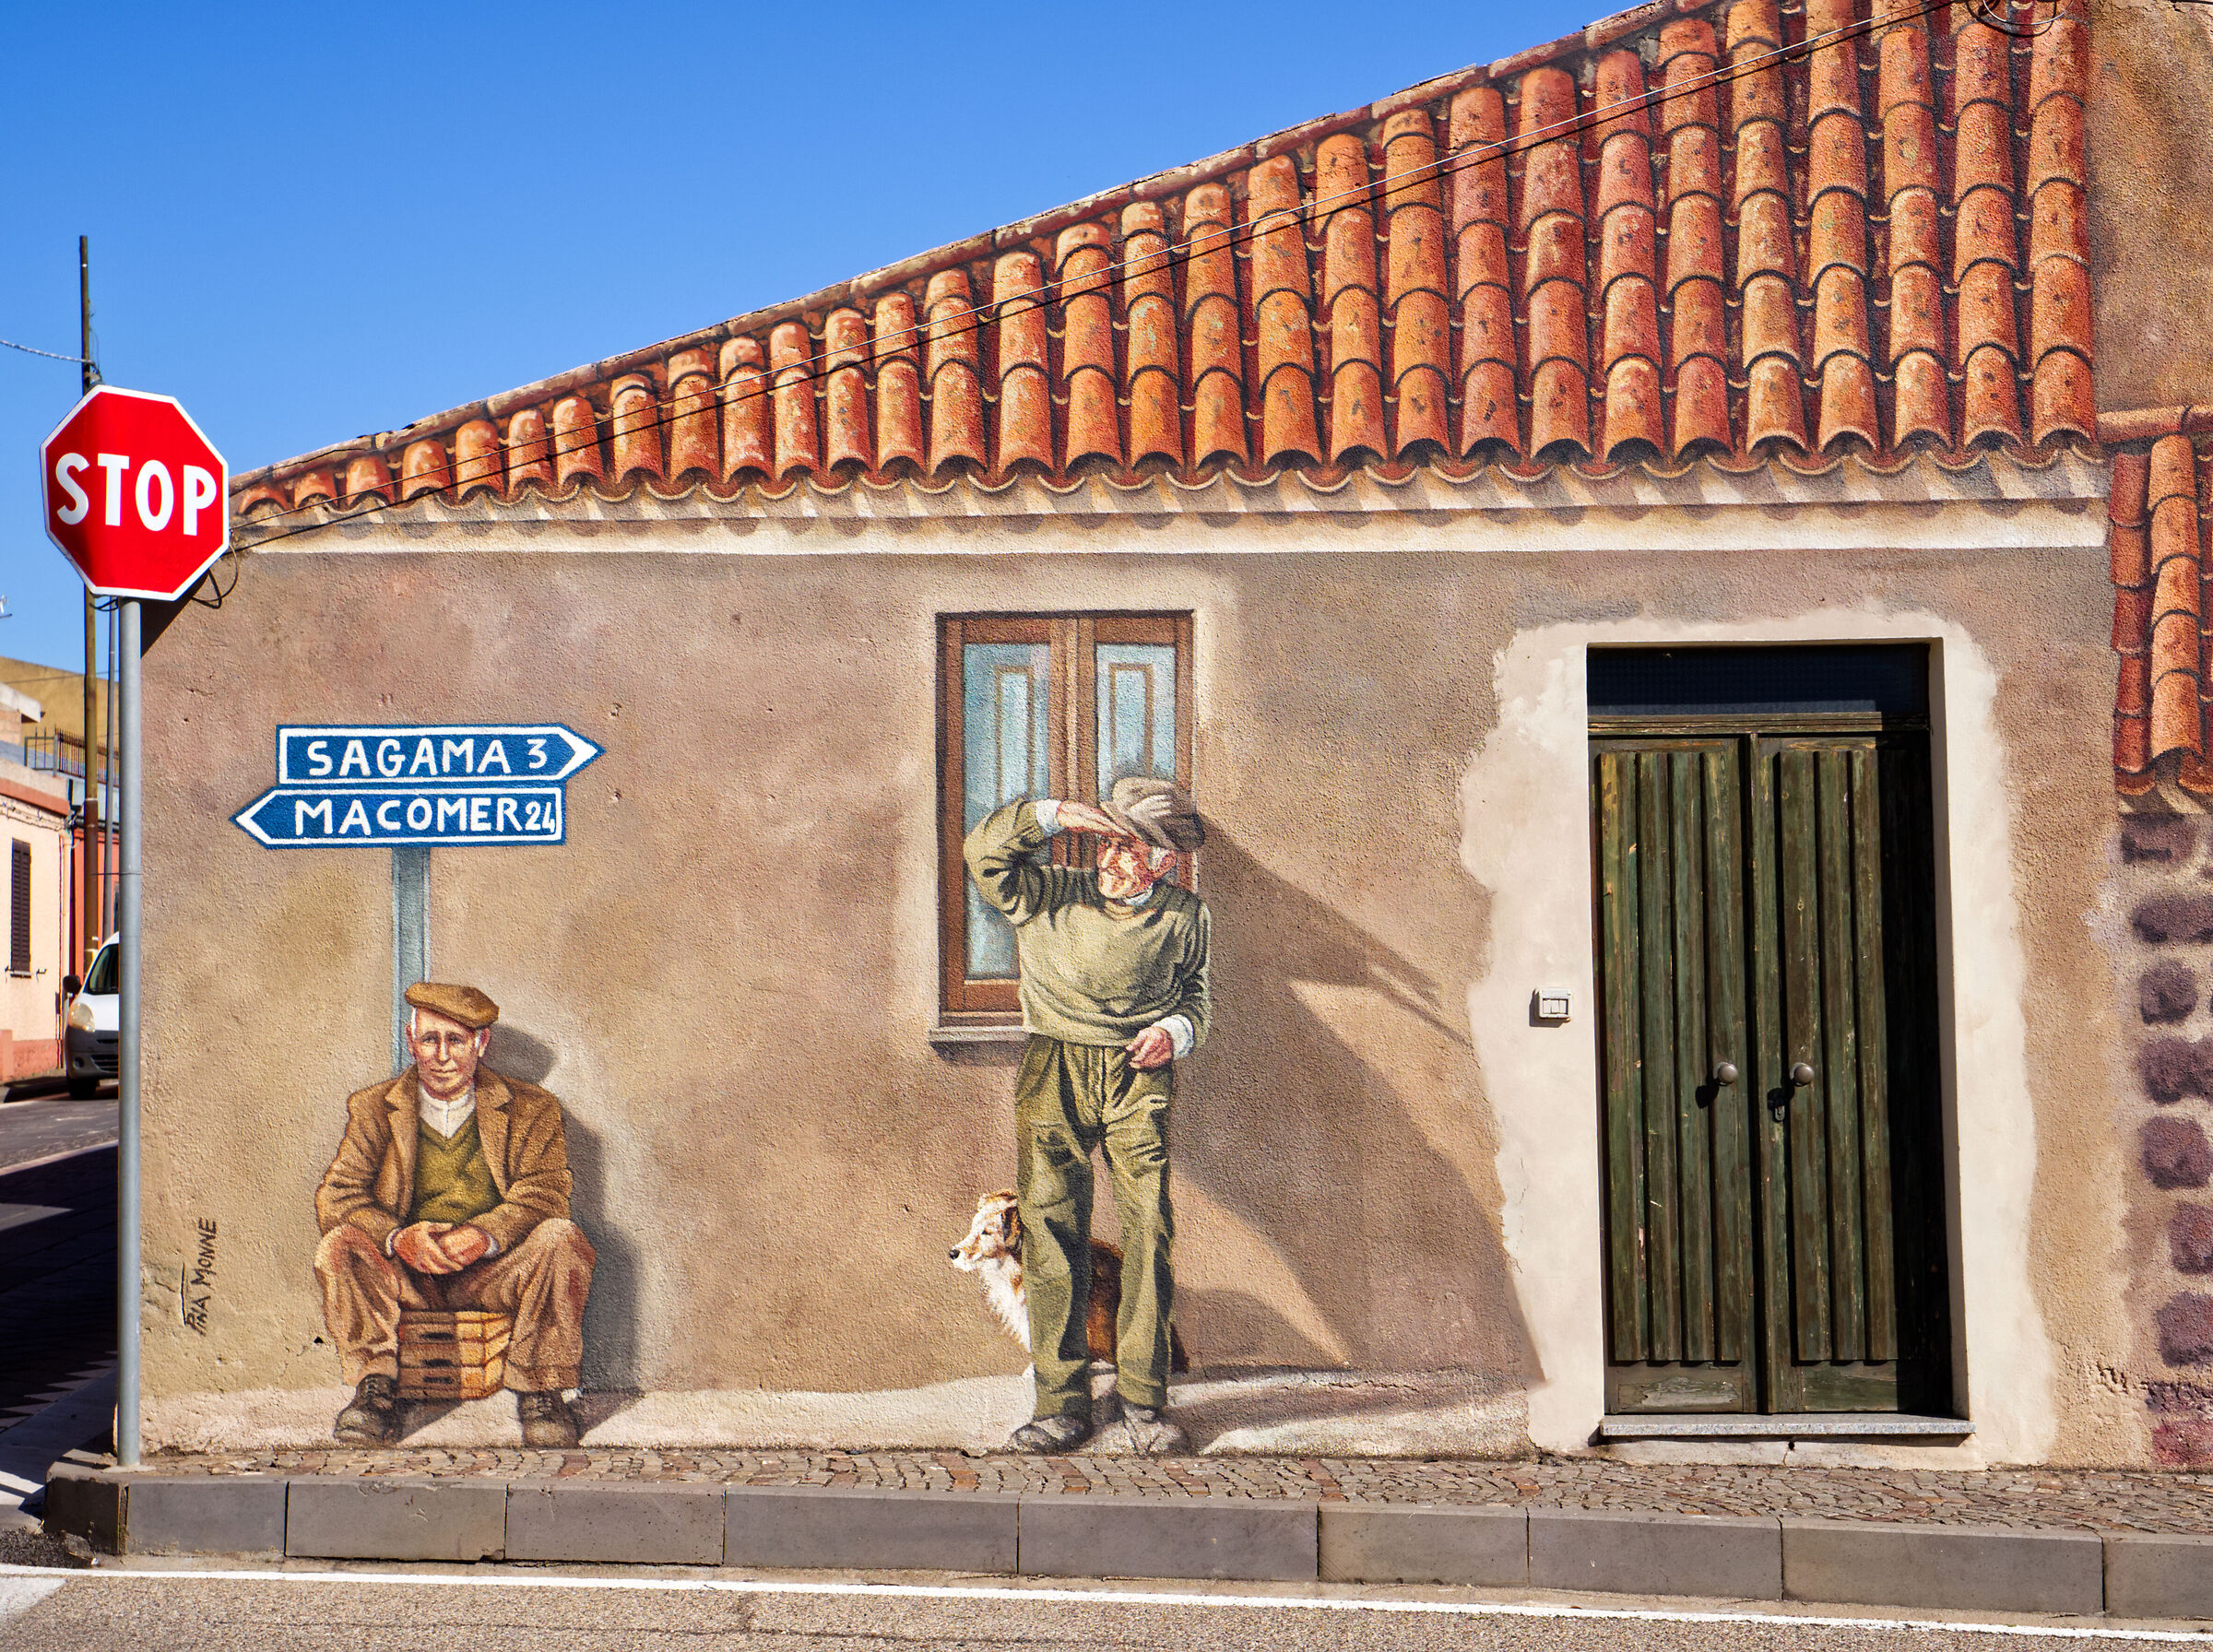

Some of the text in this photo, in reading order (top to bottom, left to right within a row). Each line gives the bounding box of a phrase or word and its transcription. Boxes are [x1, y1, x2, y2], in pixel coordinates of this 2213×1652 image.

[55, 452, 218, 537] STOP
[307, 738, 548, 777] SAGAMA 3
[295, 797, 556, 836] MACOMER 24
[191, 1217, 217, 1287] MONNE
